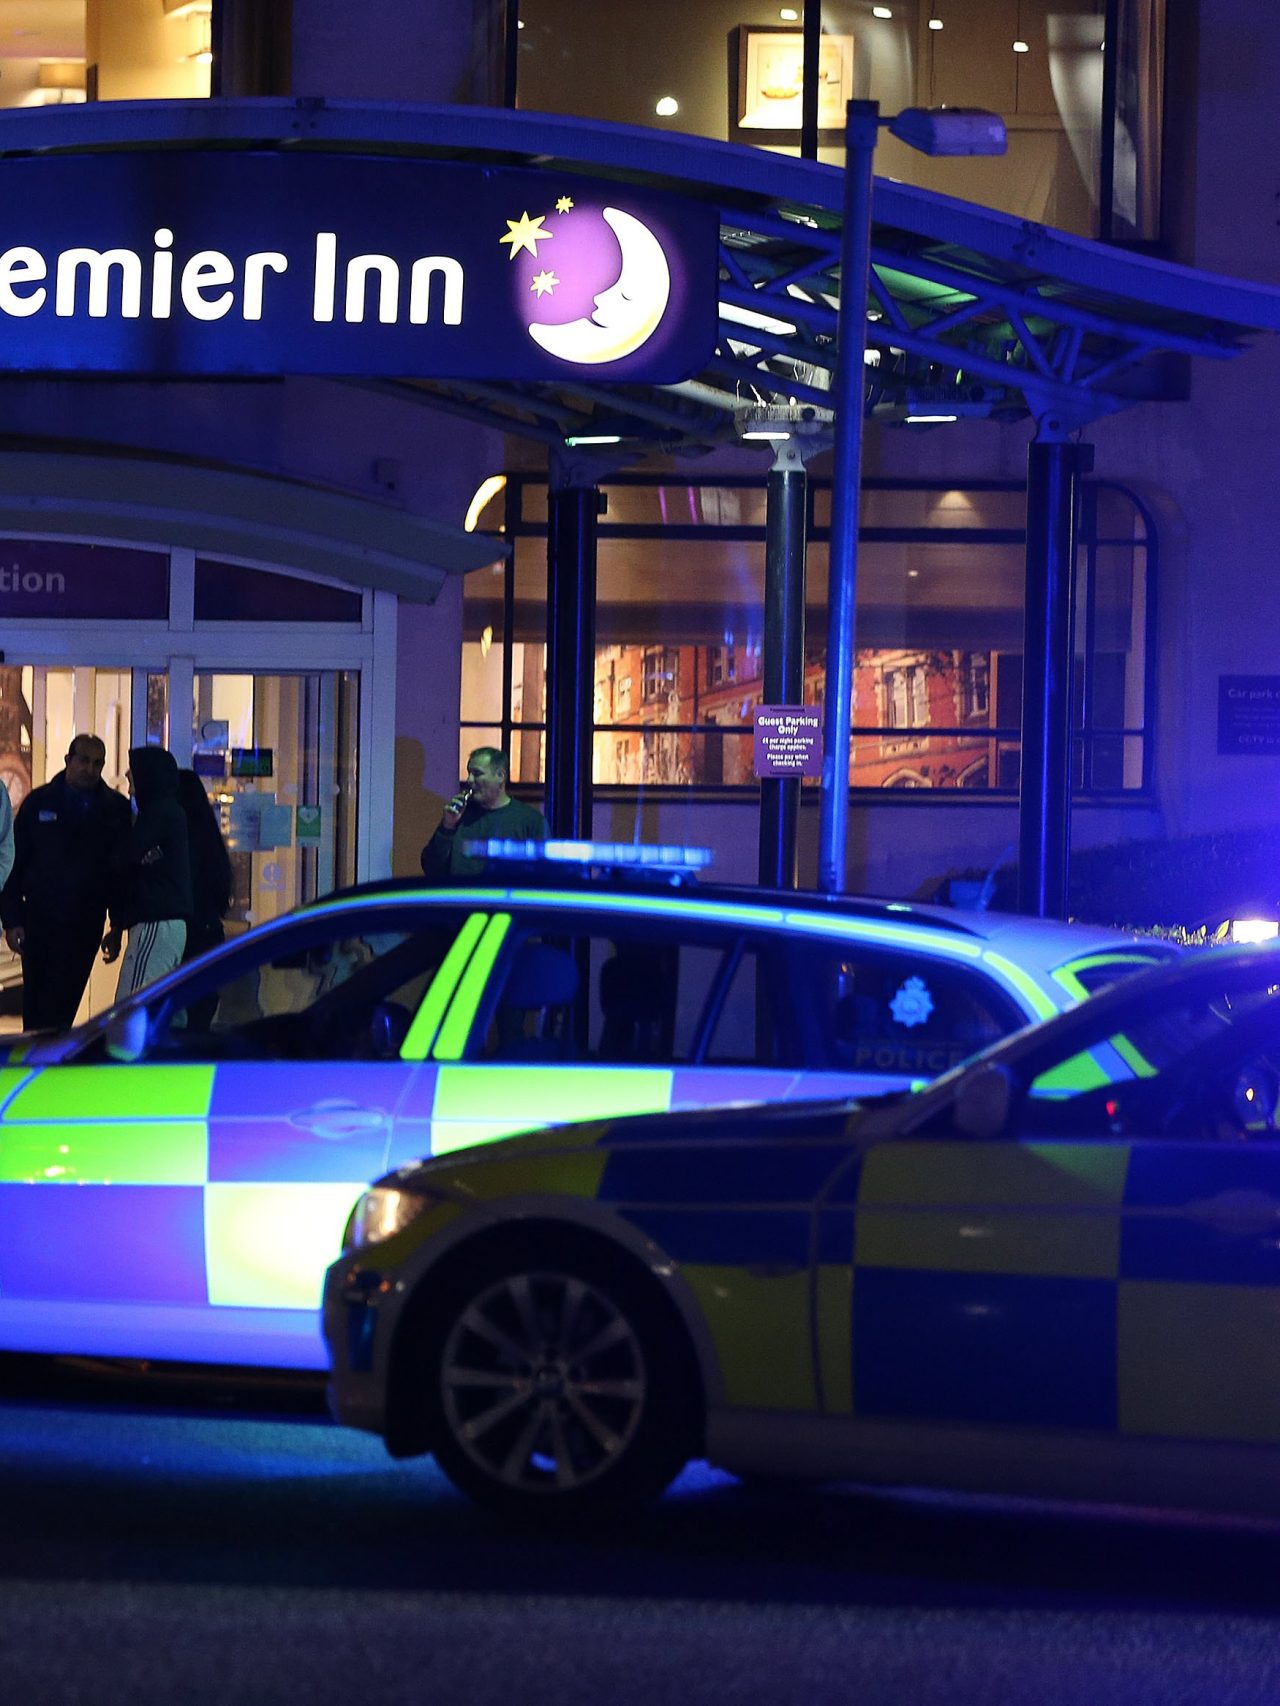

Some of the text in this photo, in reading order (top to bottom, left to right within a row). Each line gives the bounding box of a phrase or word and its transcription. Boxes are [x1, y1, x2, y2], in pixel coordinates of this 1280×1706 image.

[313, 232, 464, 325] Inn
[1228, 688, 1248, 698] Car
[1250, 688, 1273, 701] park
[758, 716, 819, 728] Guest Parking
[778, 725, 799, 736] Only
[793, 736, 814, 746] parking
